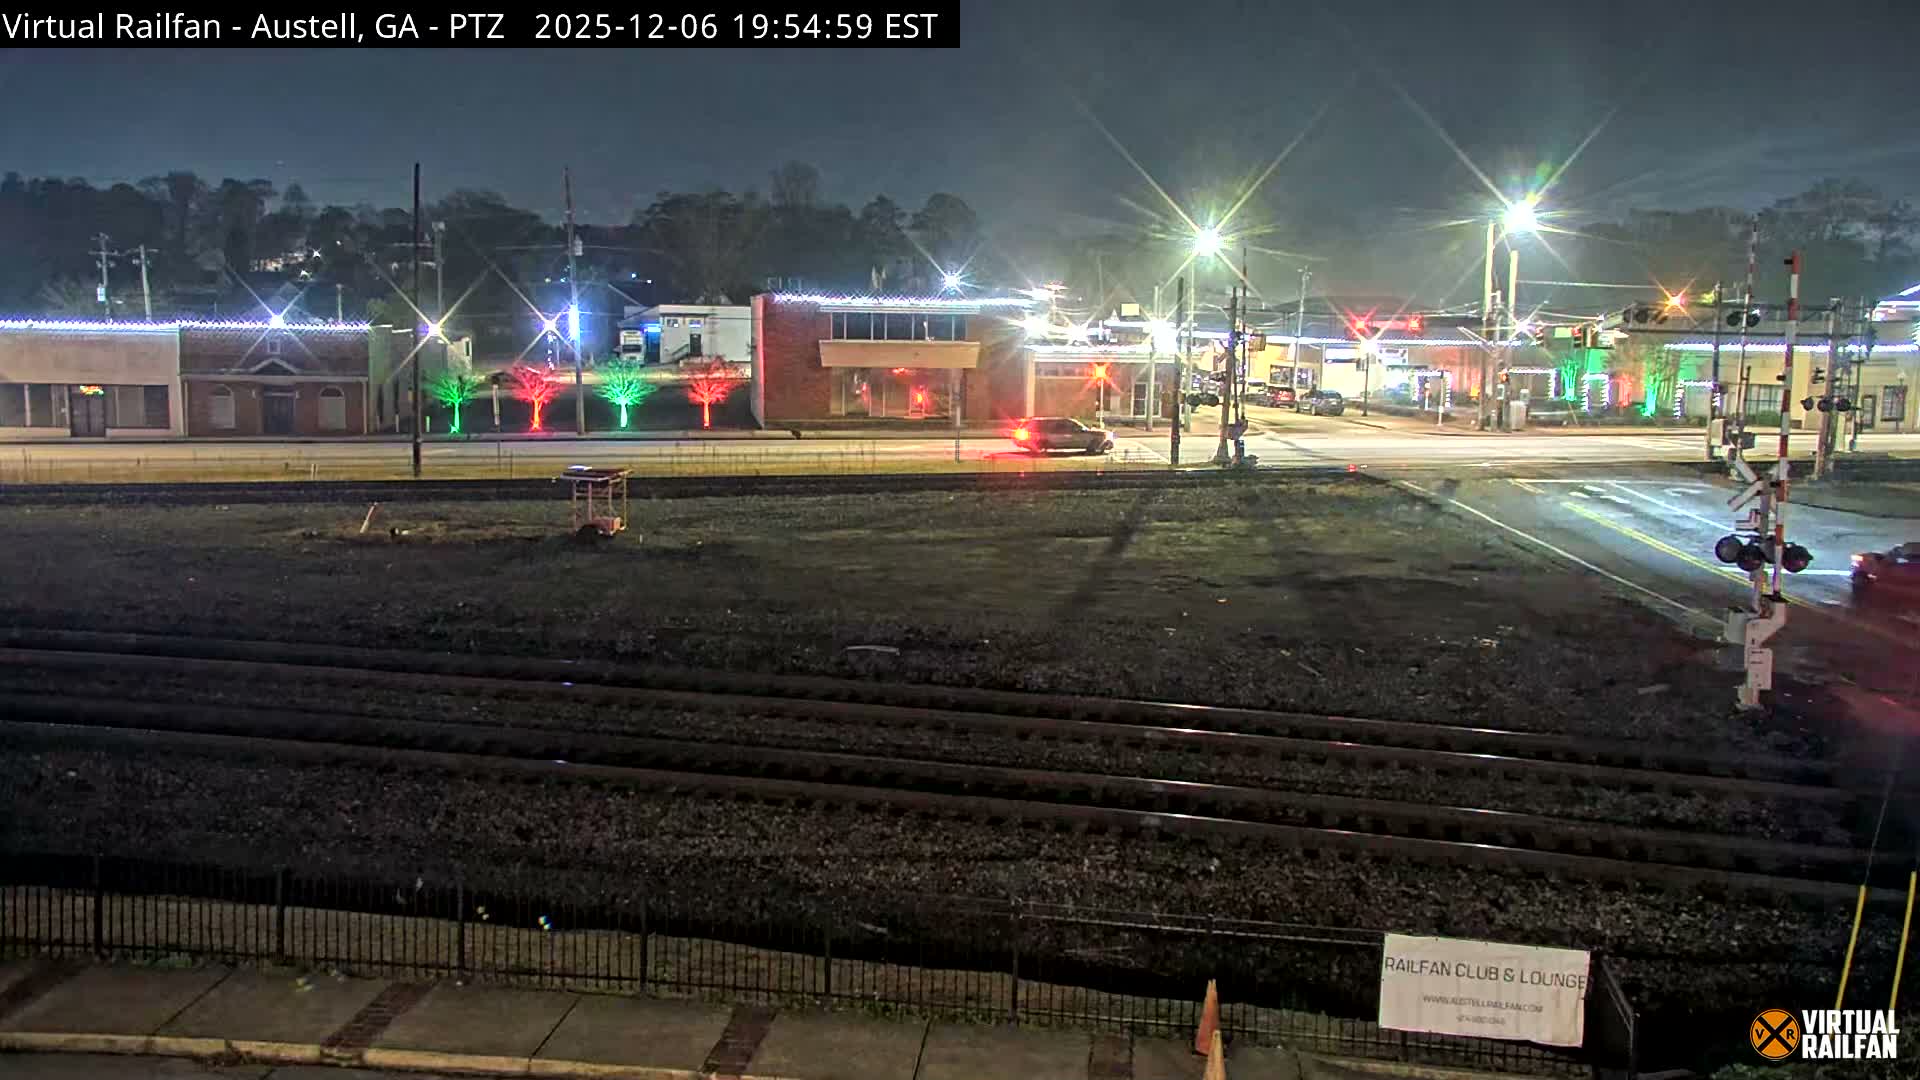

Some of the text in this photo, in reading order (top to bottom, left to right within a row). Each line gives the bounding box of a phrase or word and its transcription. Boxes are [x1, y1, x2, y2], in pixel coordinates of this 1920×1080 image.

[1385, 957, 1587, 989] RAILFAN CLUB & LOUNGE
